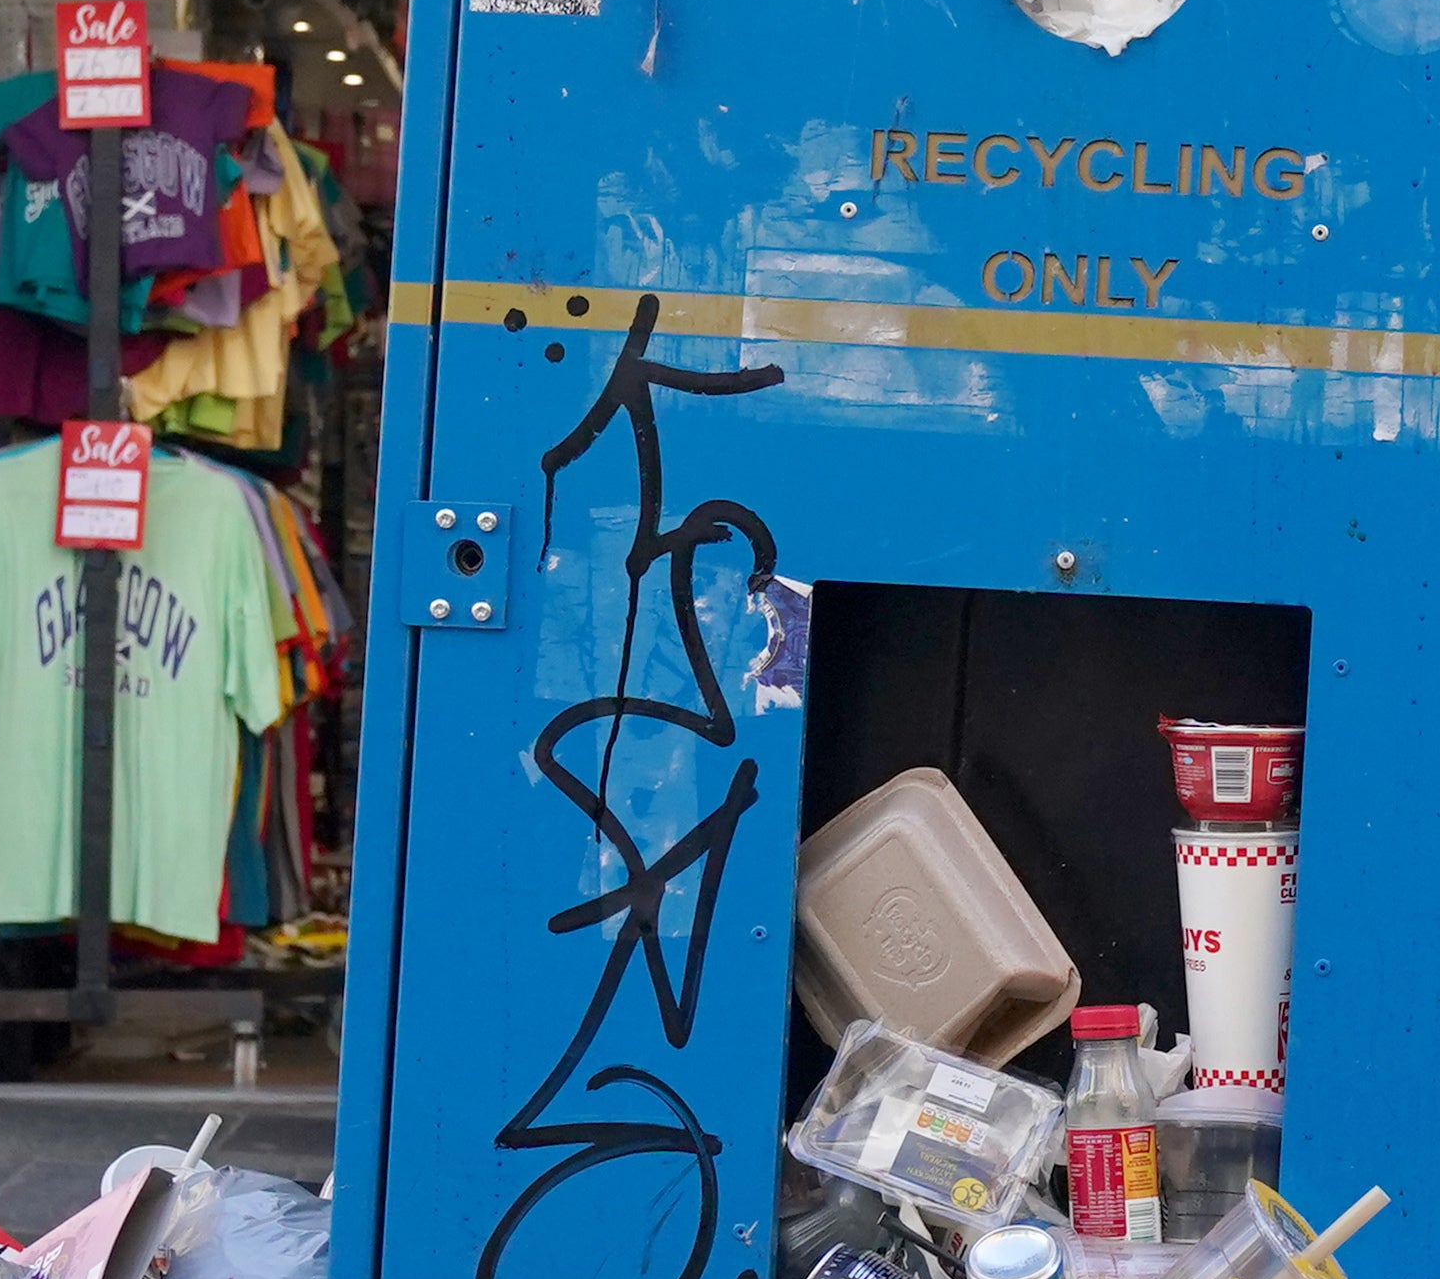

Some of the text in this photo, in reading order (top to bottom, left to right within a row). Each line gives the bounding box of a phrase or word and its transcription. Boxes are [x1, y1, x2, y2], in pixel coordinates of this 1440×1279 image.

[68, 1, 137, 45] Sale
[870, 128, 1307, 201] RECYCLING
[983, 250, 1180, 309] ONLY
[71, 424, 142, 467] Sale
[36, 566, 199, 682] GLGOW
